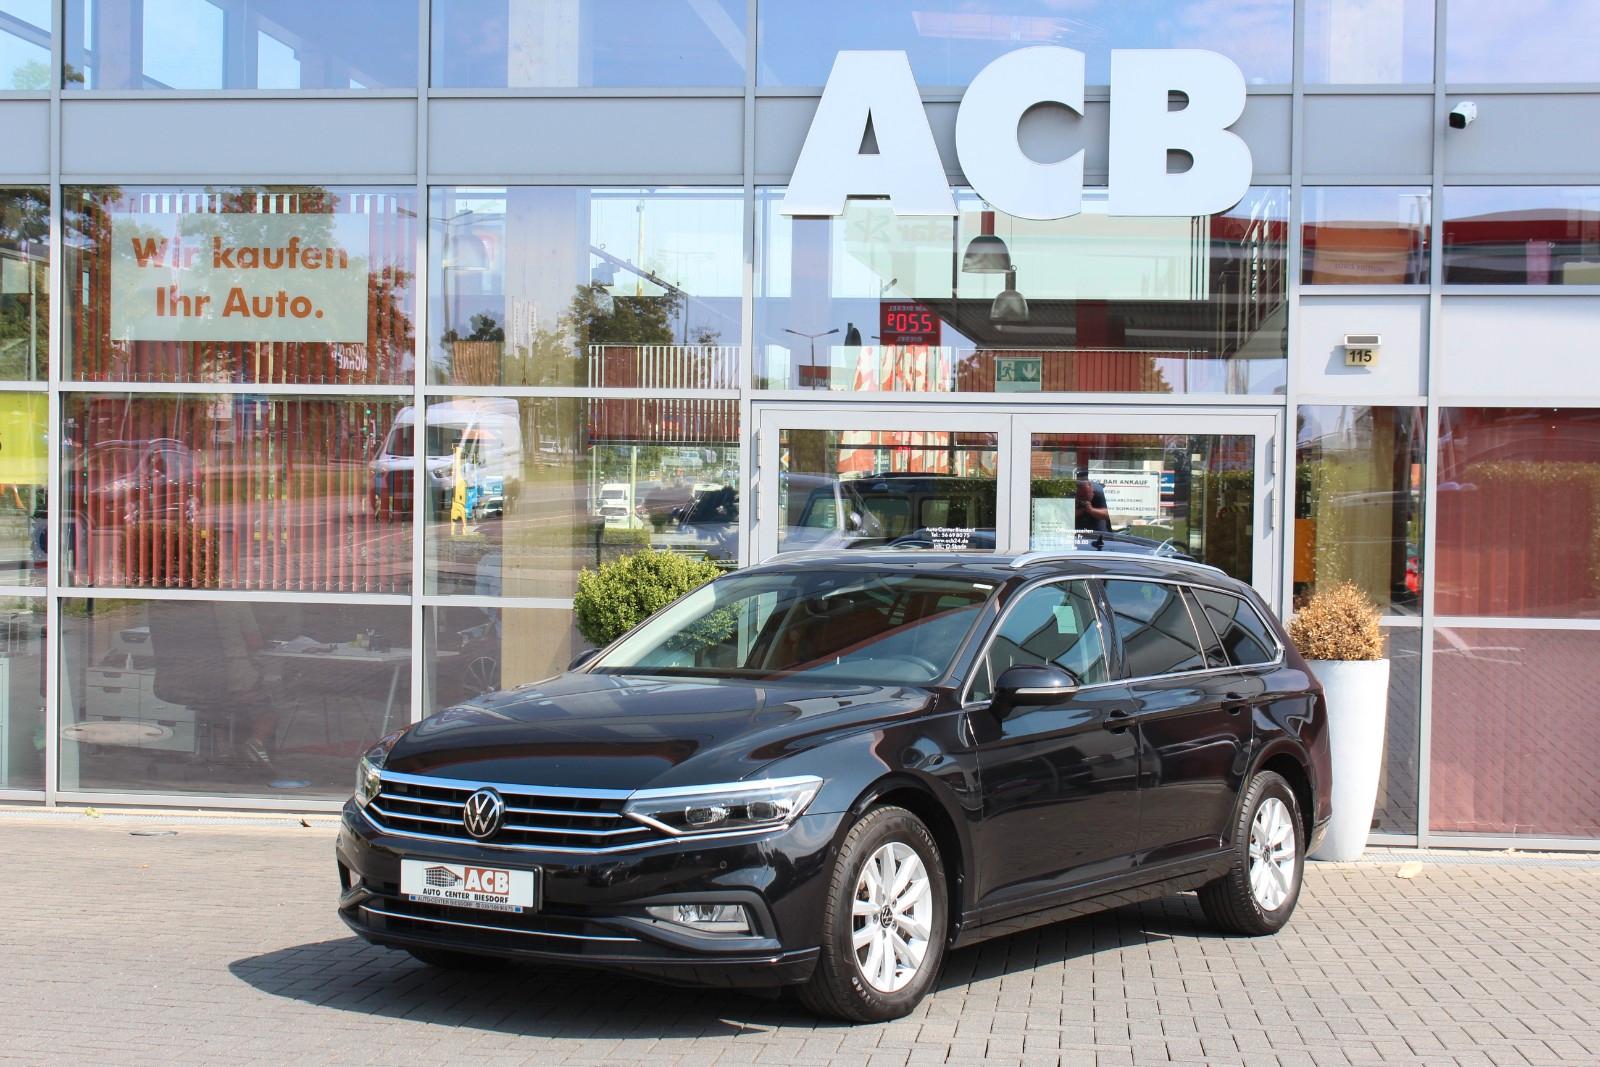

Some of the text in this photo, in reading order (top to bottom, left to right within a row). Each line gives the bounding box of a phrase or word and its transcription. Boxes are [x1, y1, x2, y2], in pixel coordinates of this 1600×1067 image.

[779, 45, 1253, 221] ACB
[132, 236, 348, 270] Wir kaufen
[156, 285, 324, 319] Ihr Auto.
[1349, 350, 1372, 362] 115
[423, 888, 509, 904] AUTO CENTER BIESDORF
[465, 868, 509, 894] ACB
